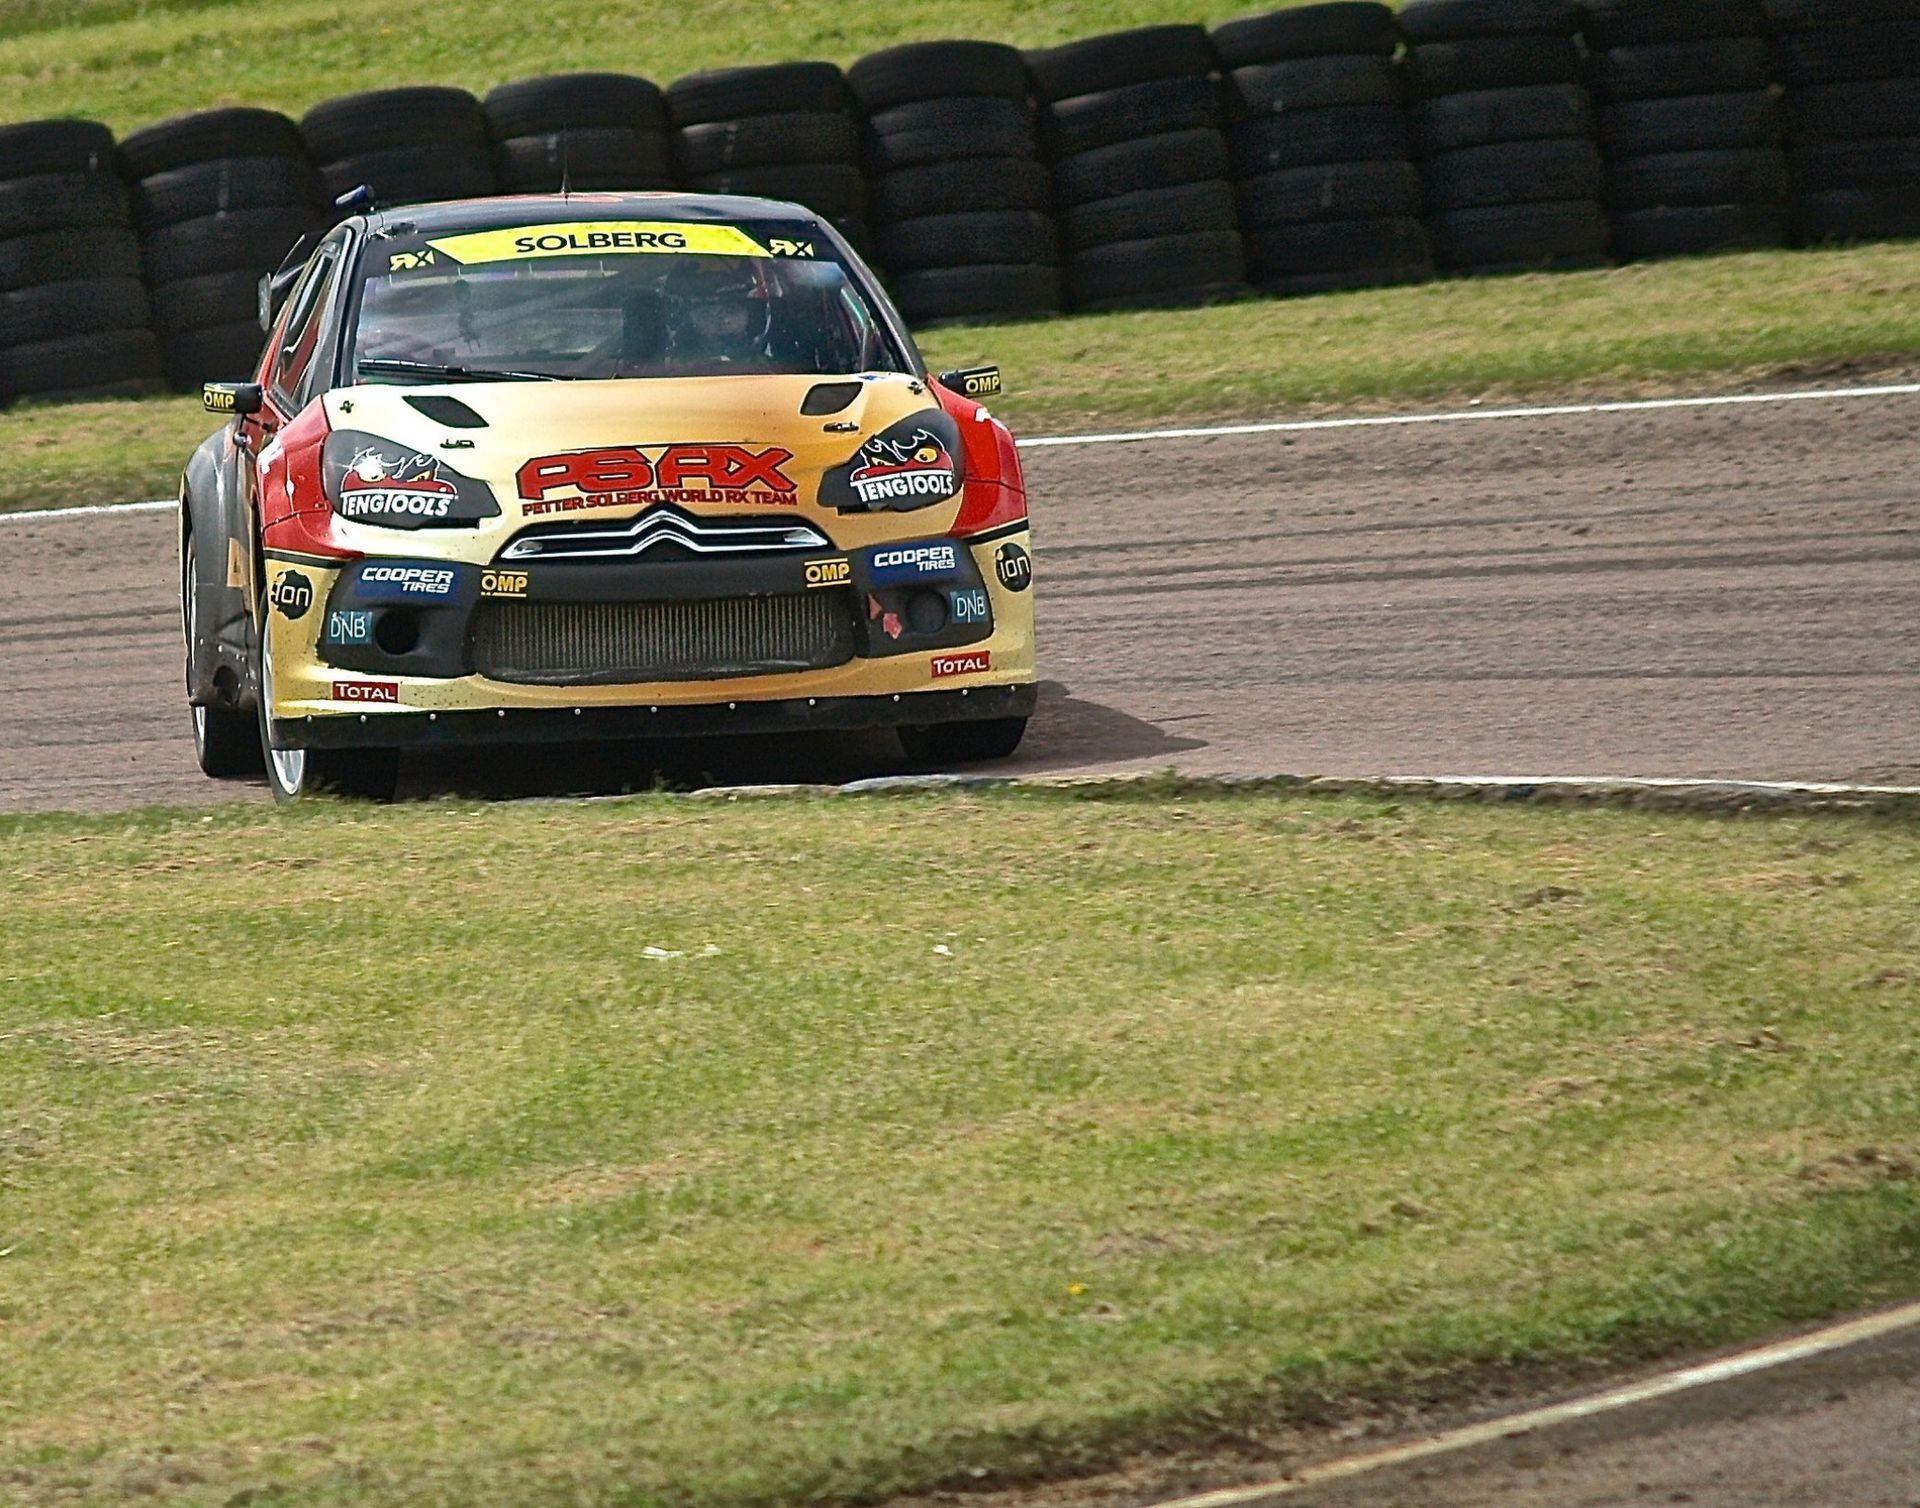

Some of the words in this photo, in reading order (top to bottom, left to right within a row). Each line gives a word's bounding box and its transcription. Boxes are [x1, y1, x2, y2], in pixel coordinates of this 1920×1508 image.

[515, 232, 686, 252] SOLBERG
[965, 376, 1000, 393] OMP
[203, 391, 235, 408] OMP
[522, 499, 584, 516] PETTER
[586, 489, 659, 508] SOLBERG
[661, 488, 727, 504] WORLD
[729, 491, 749, 504] RX
[750, 491, 798, 506] TEAM
[873, 546, 954, 568] COOPER
[916, 559, 955, 572] TIRES
[361, 567, 454, 583] COOPER
[805, 562, 851, 583] OMP
[402, 581, 451, 594] TIRES
[481, 575, 528, 593] OMP
[956, 590, 986, 623] DNB
[330, 610, 366, 645] DNB
